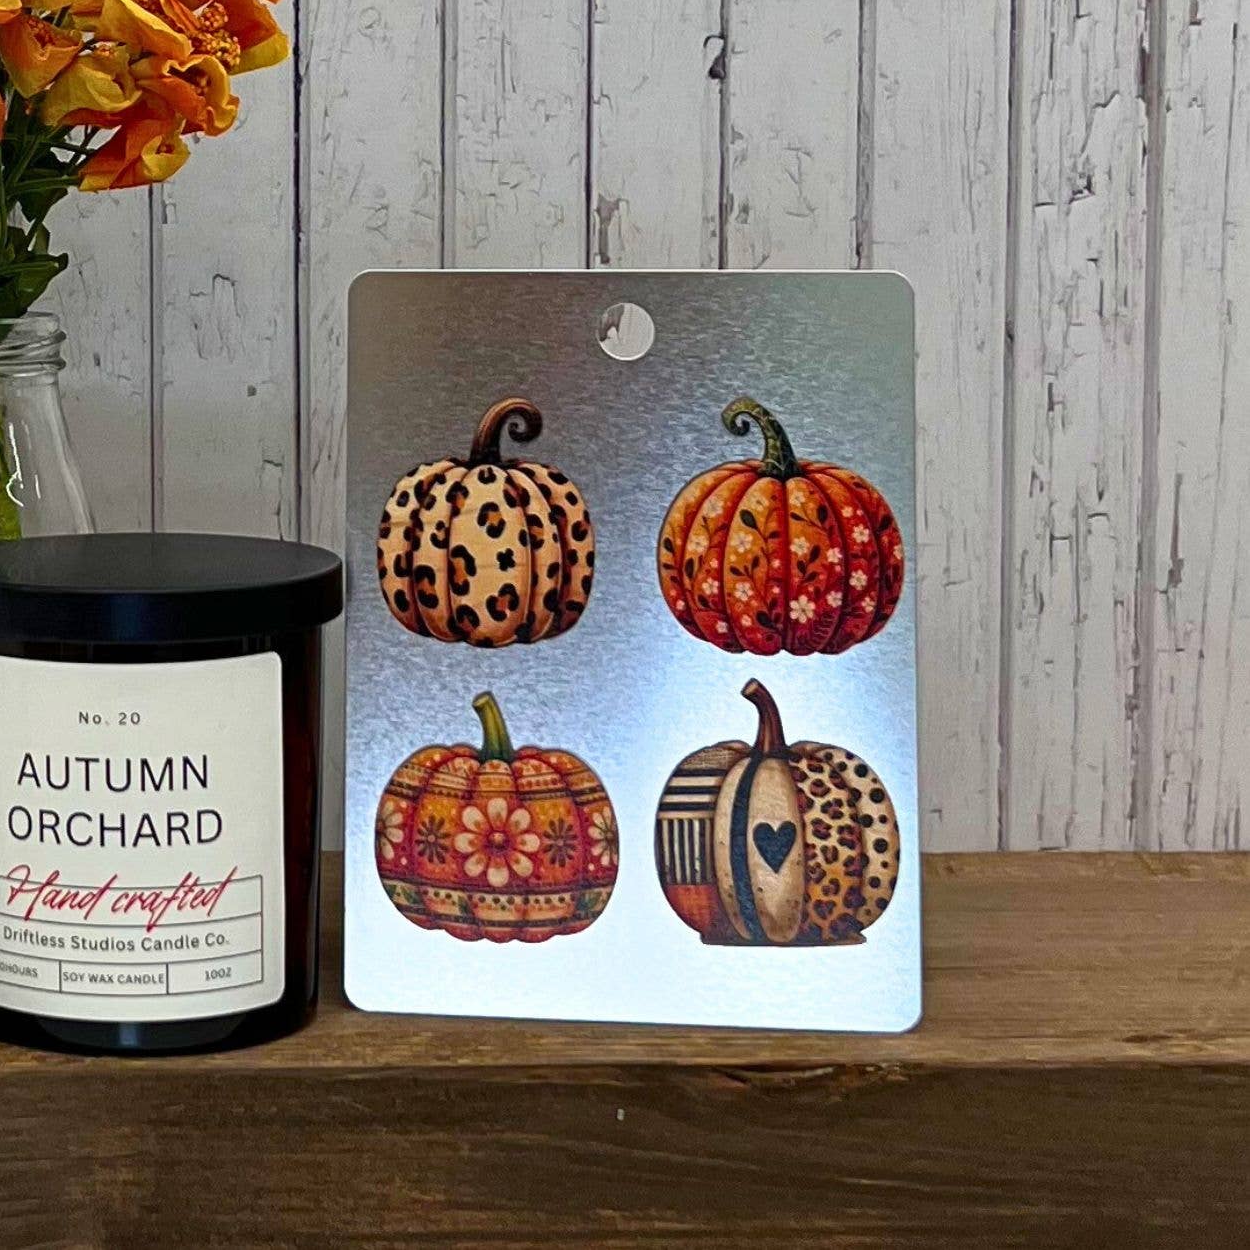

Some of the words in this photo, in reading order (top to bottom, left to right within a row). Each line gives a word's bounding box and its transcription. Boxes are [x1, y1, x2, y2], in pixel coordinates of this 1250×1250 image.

[78, 711, 110, 726] No.
[118, 711, 142, 726] 20
[17, 752, 209, 793] AUTUMN
[7, 805, 223, 848] ORCHARD
[6, 863, 119, 921] Hand
[111, 866, 238, 932] crafted
[3, 925, 66, 948] Driftless
[70, 935, 135, 952] Studios
[141, 933, 200, 952] Candle
[204, 931, 230, 946] Co.
[62, 970, 86, 983] SOY
[88, 973, 114, 985] WAX
[118, 973, 165, 986] CANDLE
